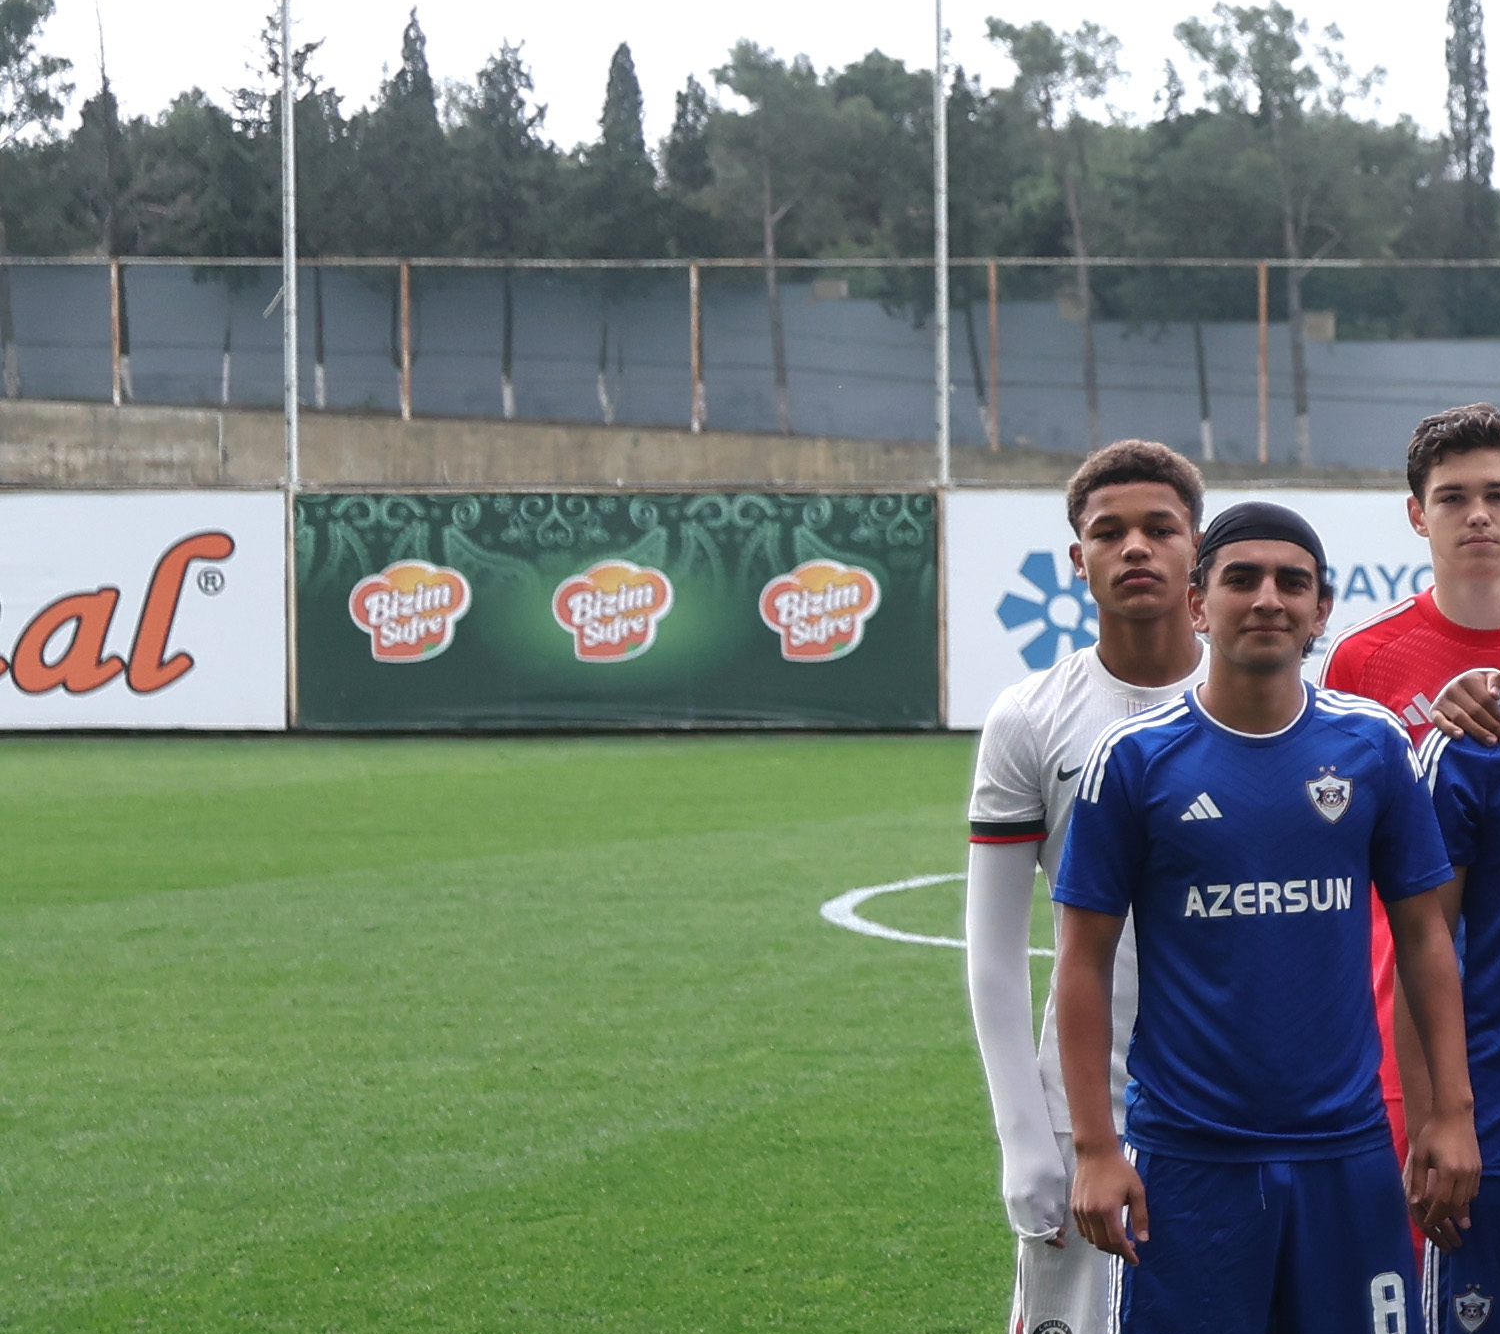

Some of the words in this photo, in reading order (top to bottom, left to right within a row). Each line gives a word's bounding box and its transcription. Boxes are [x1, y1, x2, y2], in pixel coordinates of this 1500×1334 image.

[0, 531, 236, 694] al
[364, 583, 451, 625] Bizim
[567, 583, 654, 625] Bizim
[774, 582, 859, 625] Bizim
[1184, 876, 1352, 917] AZERSUN
